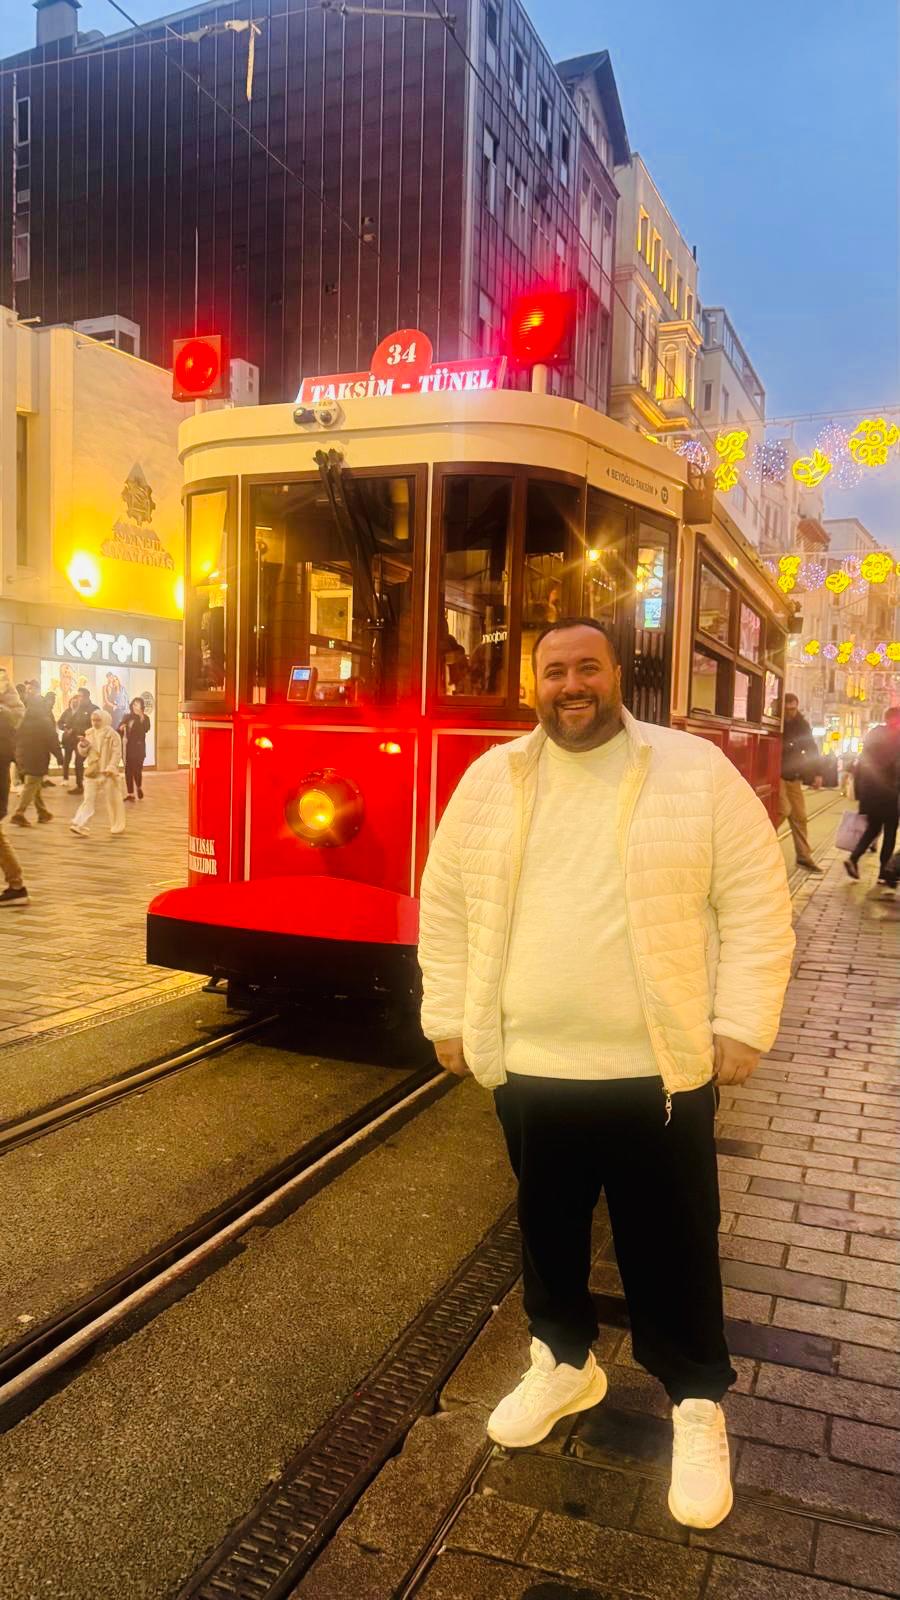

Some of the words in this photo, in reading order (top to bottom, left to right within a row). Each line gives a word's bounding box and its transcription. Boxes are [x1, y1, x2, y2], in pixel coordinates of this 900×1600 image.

[387, 342, 416, 365] 34
[311, 375, 394, 402] TAKSİM
[419, 367, 494, 393] TÜNEL
[56, 628, 151, 664] KOTON
